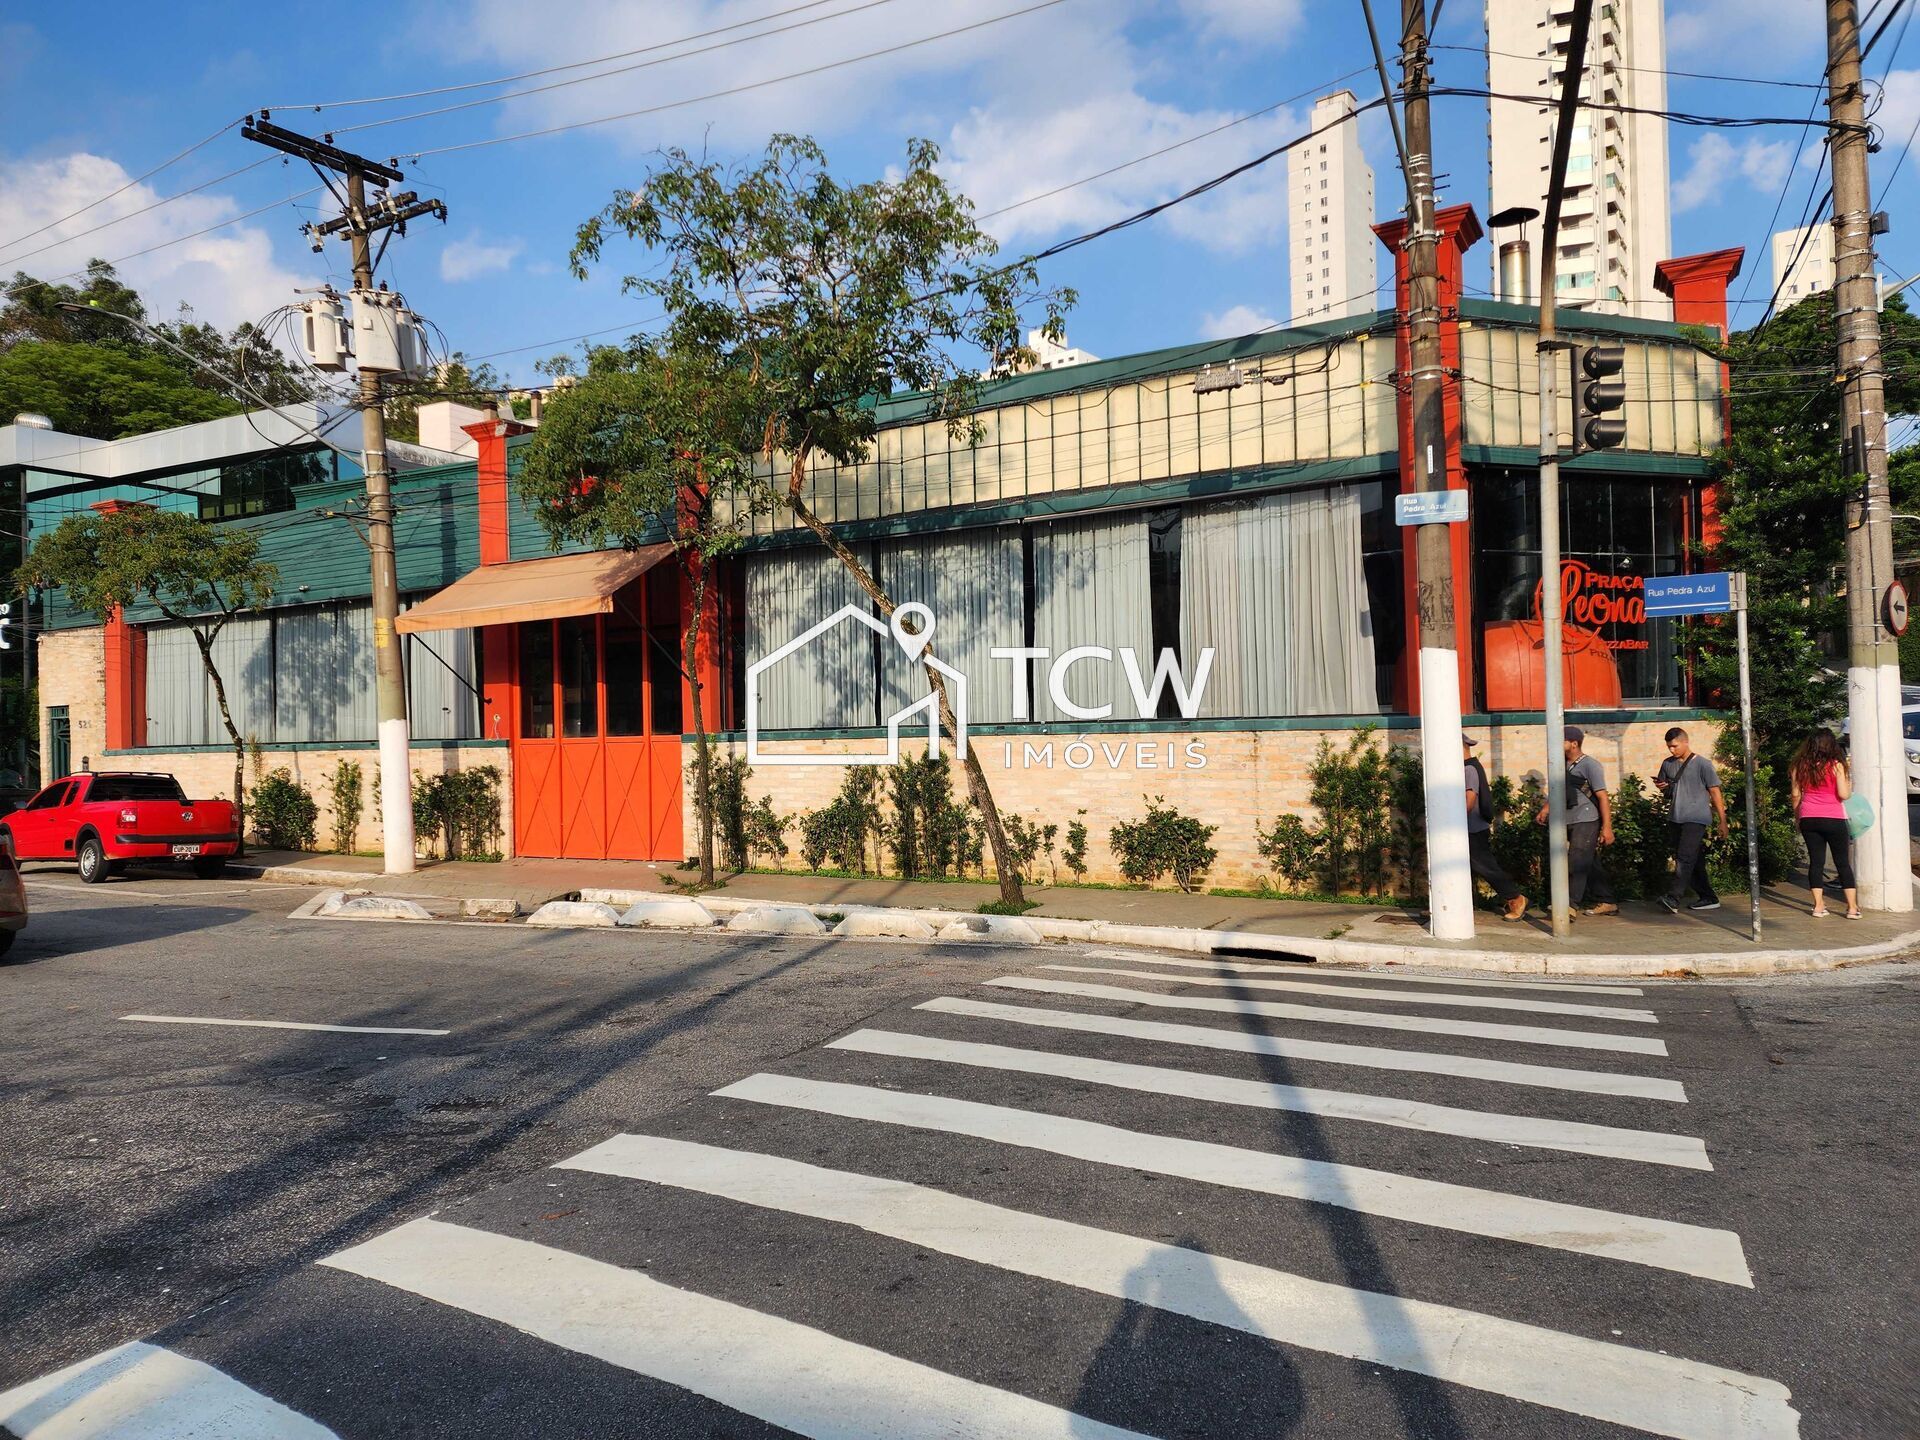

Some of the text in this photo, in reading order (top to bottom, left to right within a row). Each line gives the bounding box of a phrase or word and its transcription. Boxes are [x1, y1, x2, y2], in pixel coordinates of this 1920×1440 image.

[1585, 573, 1644, 591] PRAÇA
[1648, 584, 1716, 597] Rua Pedra Azul
